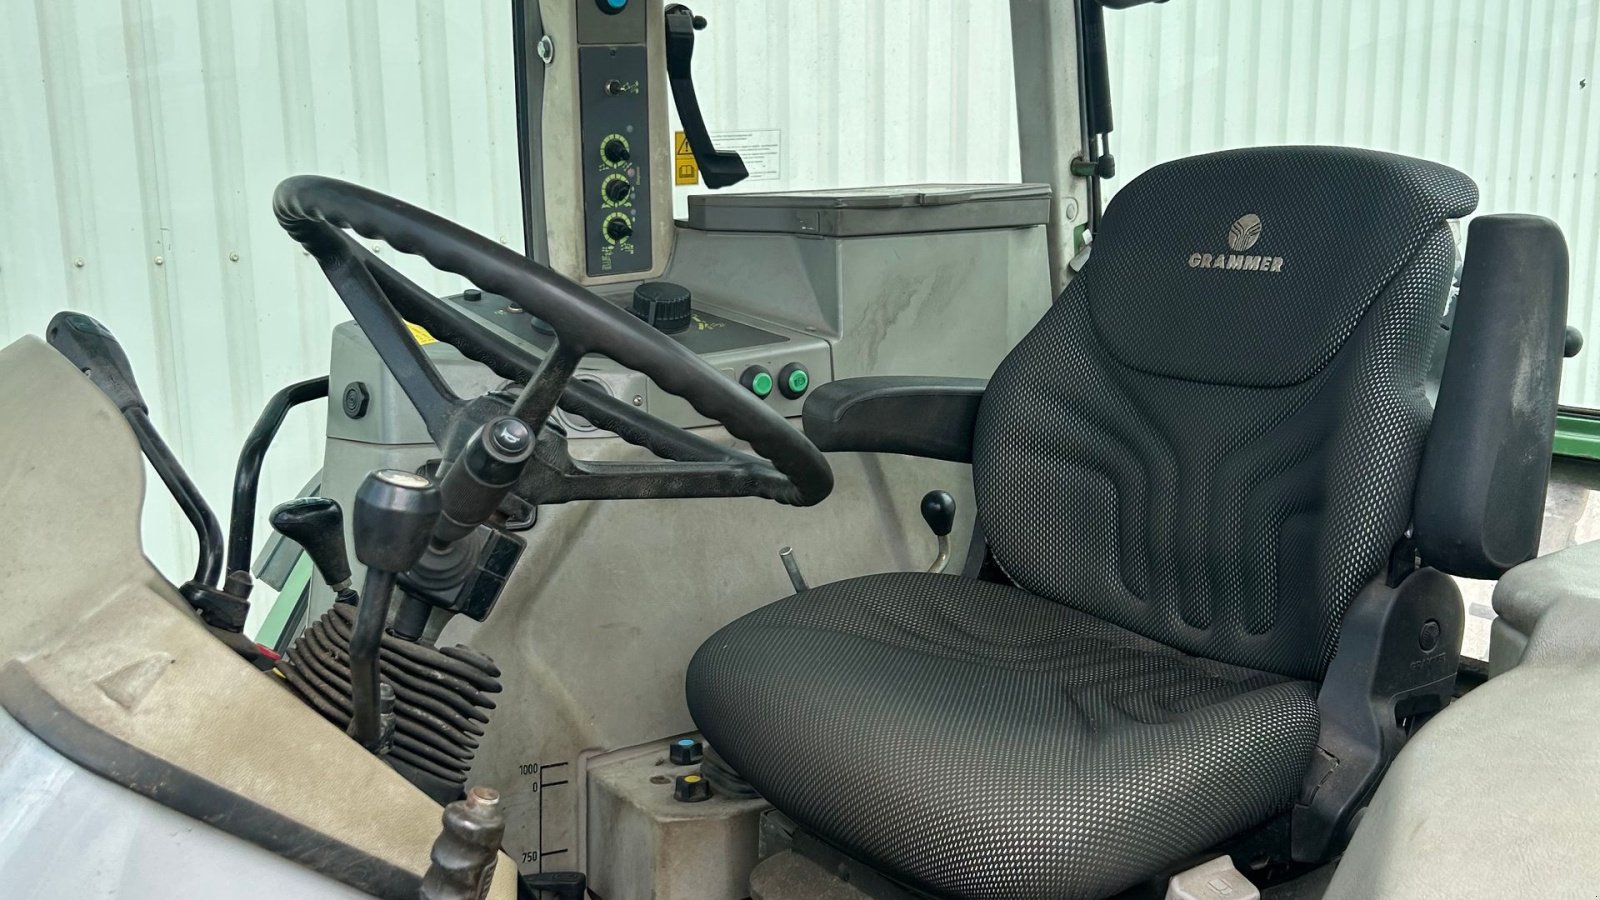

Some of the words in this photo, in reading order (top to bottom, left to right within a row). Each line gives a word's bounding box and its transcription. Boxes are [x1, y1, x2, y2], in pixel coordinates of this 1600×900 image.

[1188, 252, 1283, 272] GRAMMER
[519, 763, 538, 775] 1000
[532, 782, 538, 792] 0
[522, 851, 538, 863] 750
